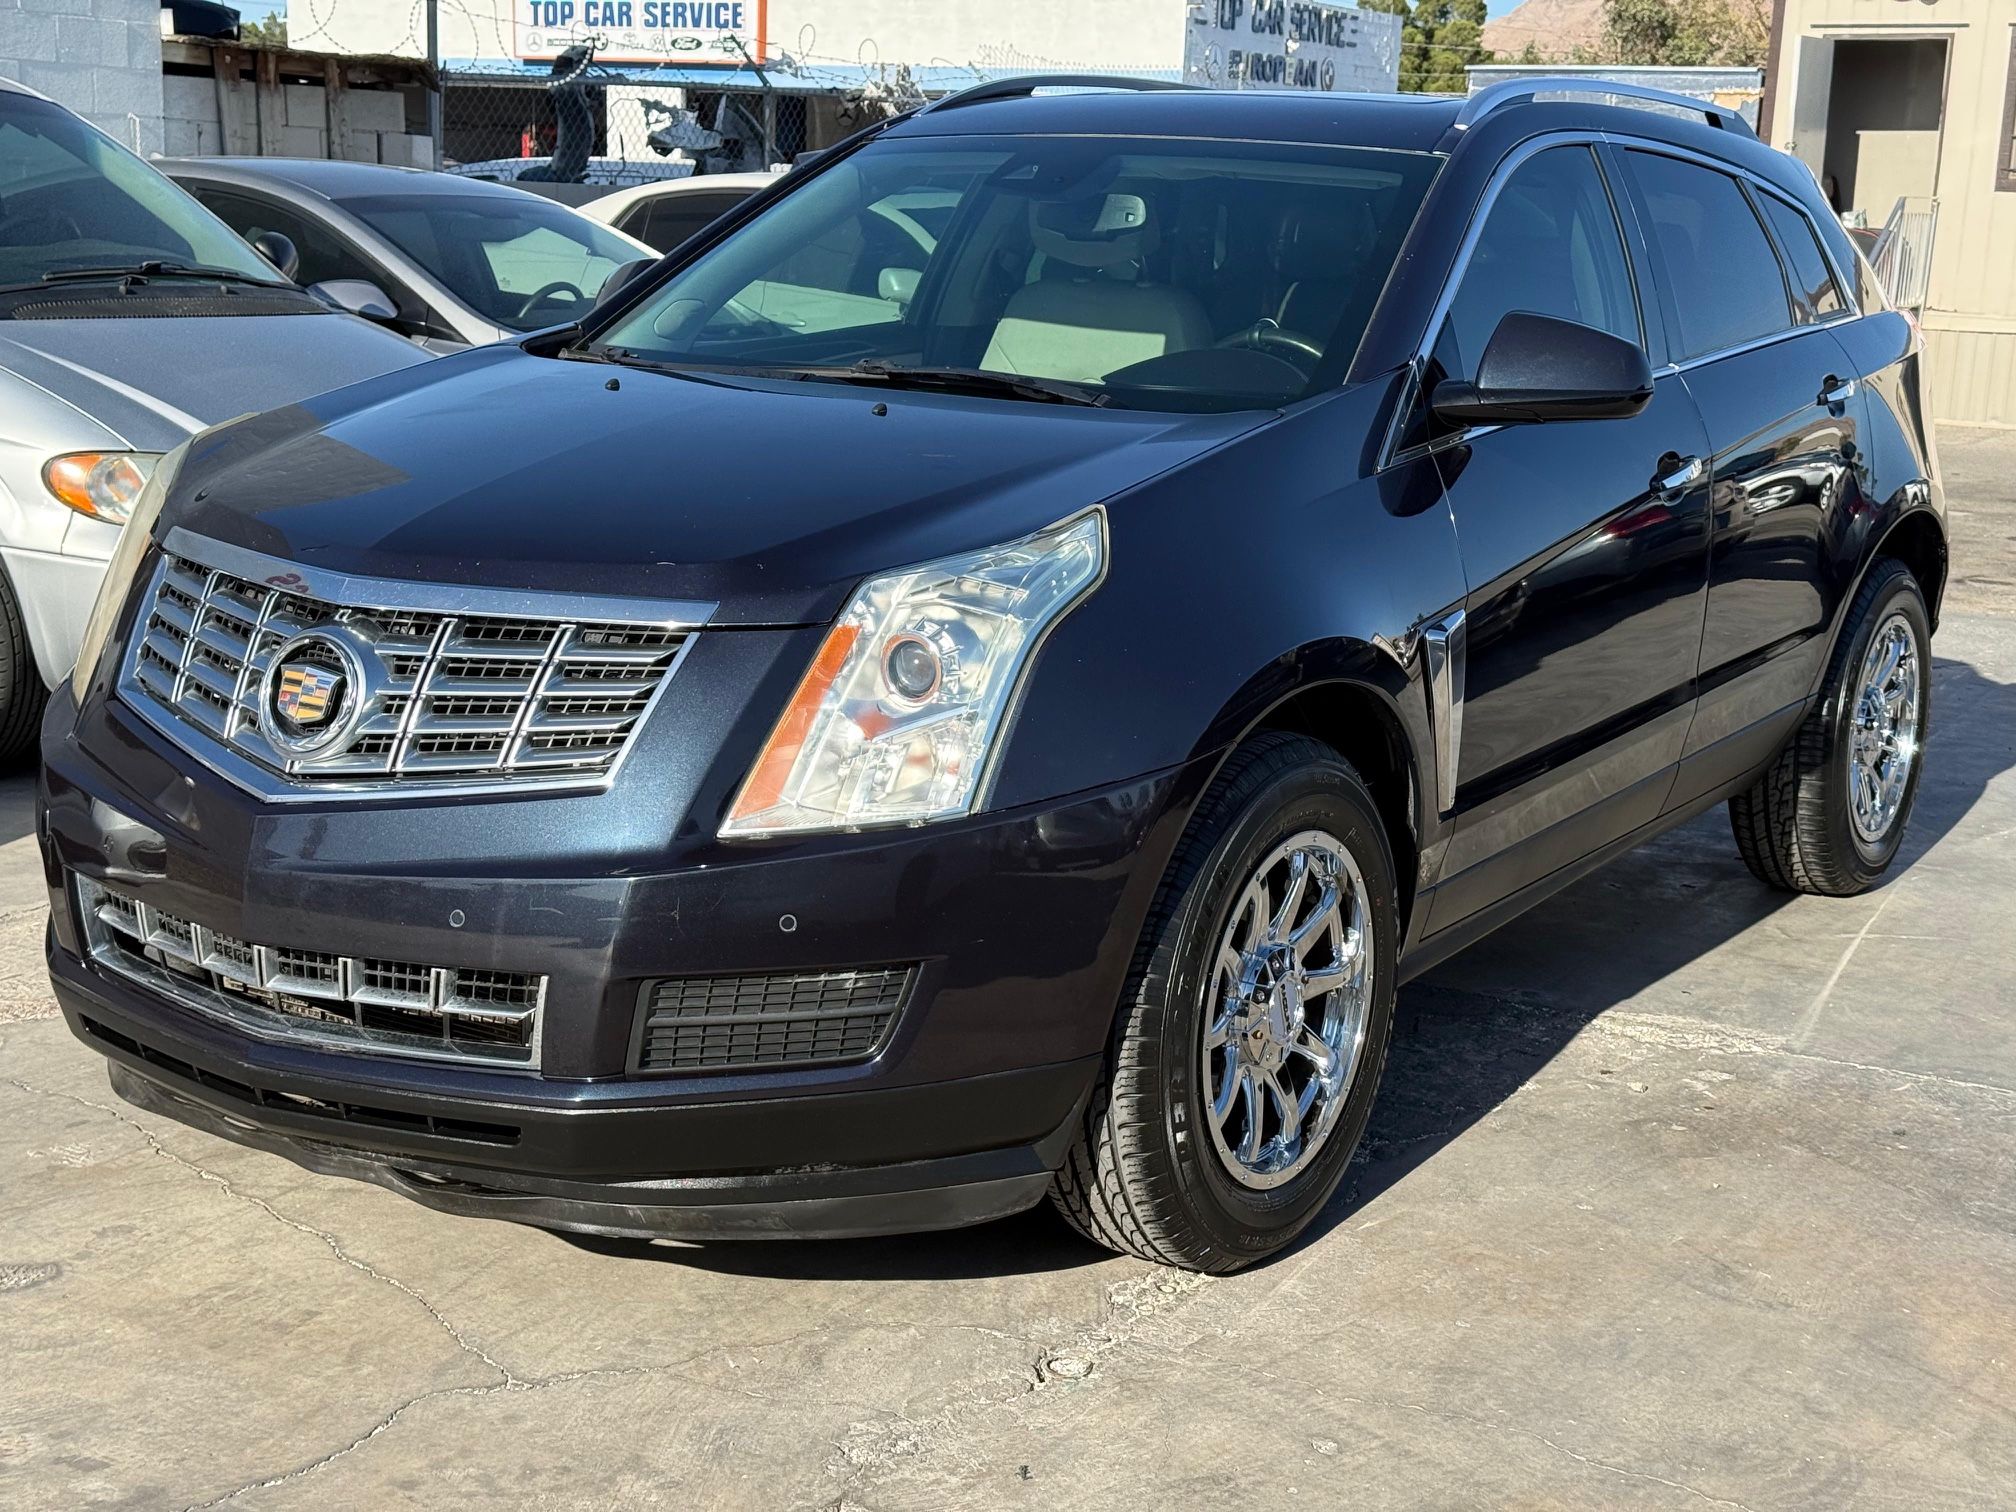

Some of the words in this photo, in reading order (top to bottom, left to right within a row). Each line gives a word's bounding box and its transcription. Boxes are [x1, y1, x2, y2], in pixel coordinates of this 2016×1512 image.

[530, 1, 574, 28] TOP
[584, 1, 632, 28] CAR
[644, 1, 743, 29] SERVICE
[1251, 0, 1284, 36] CAR
[1289, 2, 1346, 48] SERVICE
